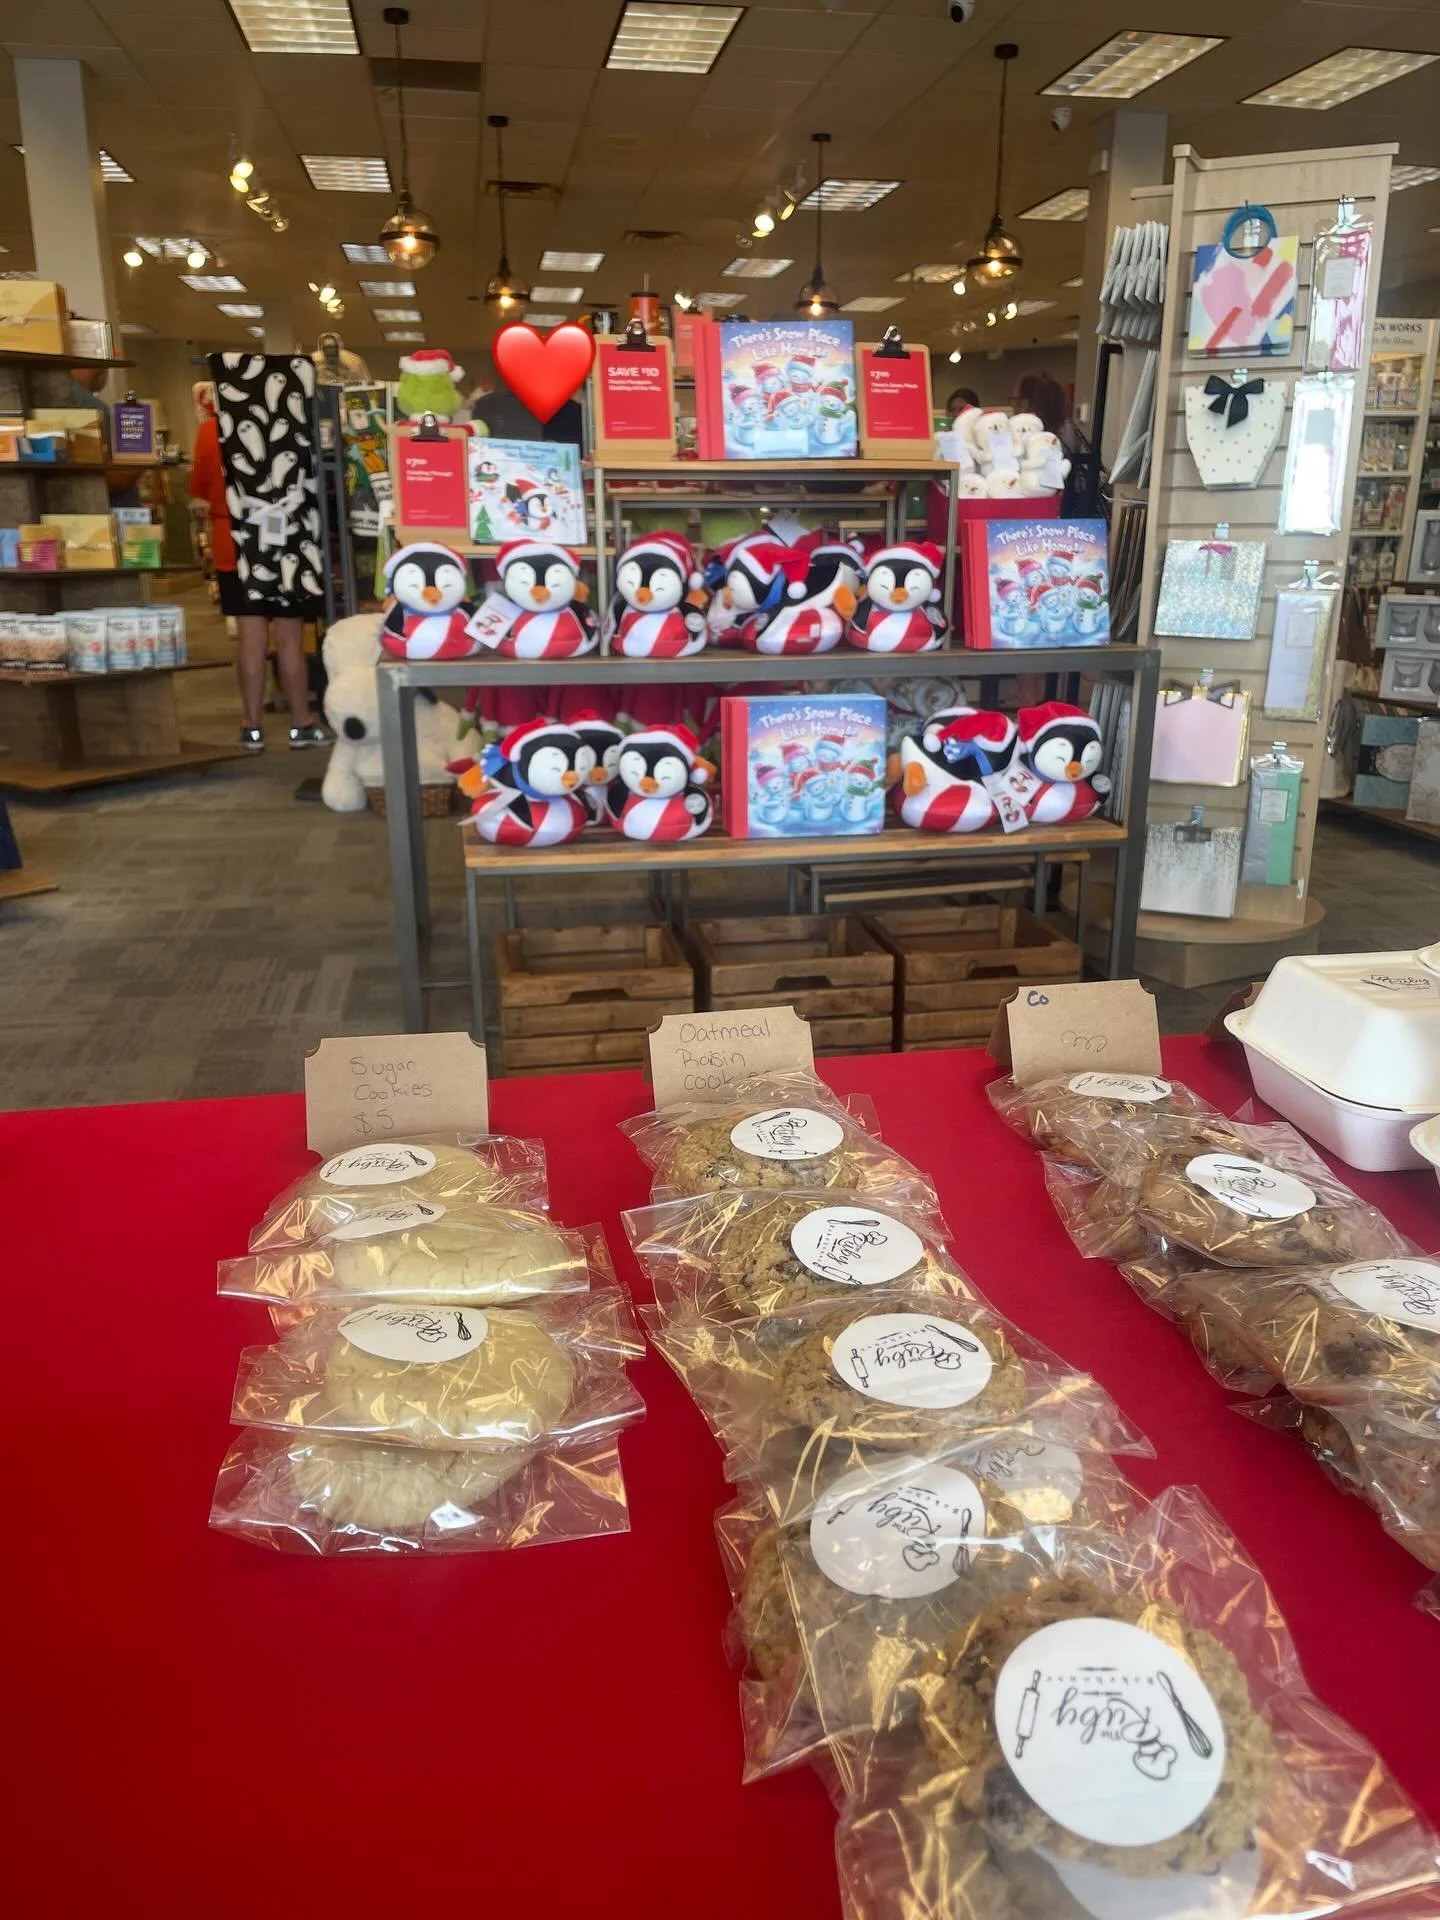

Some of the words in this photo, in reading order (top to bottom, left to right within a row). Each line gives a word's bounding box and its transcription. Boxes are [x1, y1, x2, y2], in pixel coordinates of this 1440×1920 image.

[729, 327, 771, 348] There's
[773, 327, 806, 342] Snow
[808, 327, 841, 348] Place
[607, 366, 640, 377] SAVE
[641, 366, 660, 377] $10
[995, 527, 1033, 545] There's
[1036, 525, 1065, 538] Snow
[1067, 525, 1097, 543] Place
[1016, 542, 1040, 556] Like
[758, 708, 801, 728] There's
[804, 706, 836, 721] Snow
[839, 706, 873, 726] Place
[780, 725, 807, 740] Like
[679, 1015, 772, 1044] Oatmeal
[675, 1048, 746, 1068] Raisin
[350, 1056, 416, 1085] Sugar
[354, 1083, 433, 1101] Cookies
[826, 1232, 867, 1265] Ruby
[1375, 1274, 1439, 1307] Ruby
[375, 1312, 442, 1331] Ruby
[874, 1340, 945, 1369] Ruby
[867, 1491, 942, 1540] Ruby
[1051, 1686, 1161, 1746] Ruby
